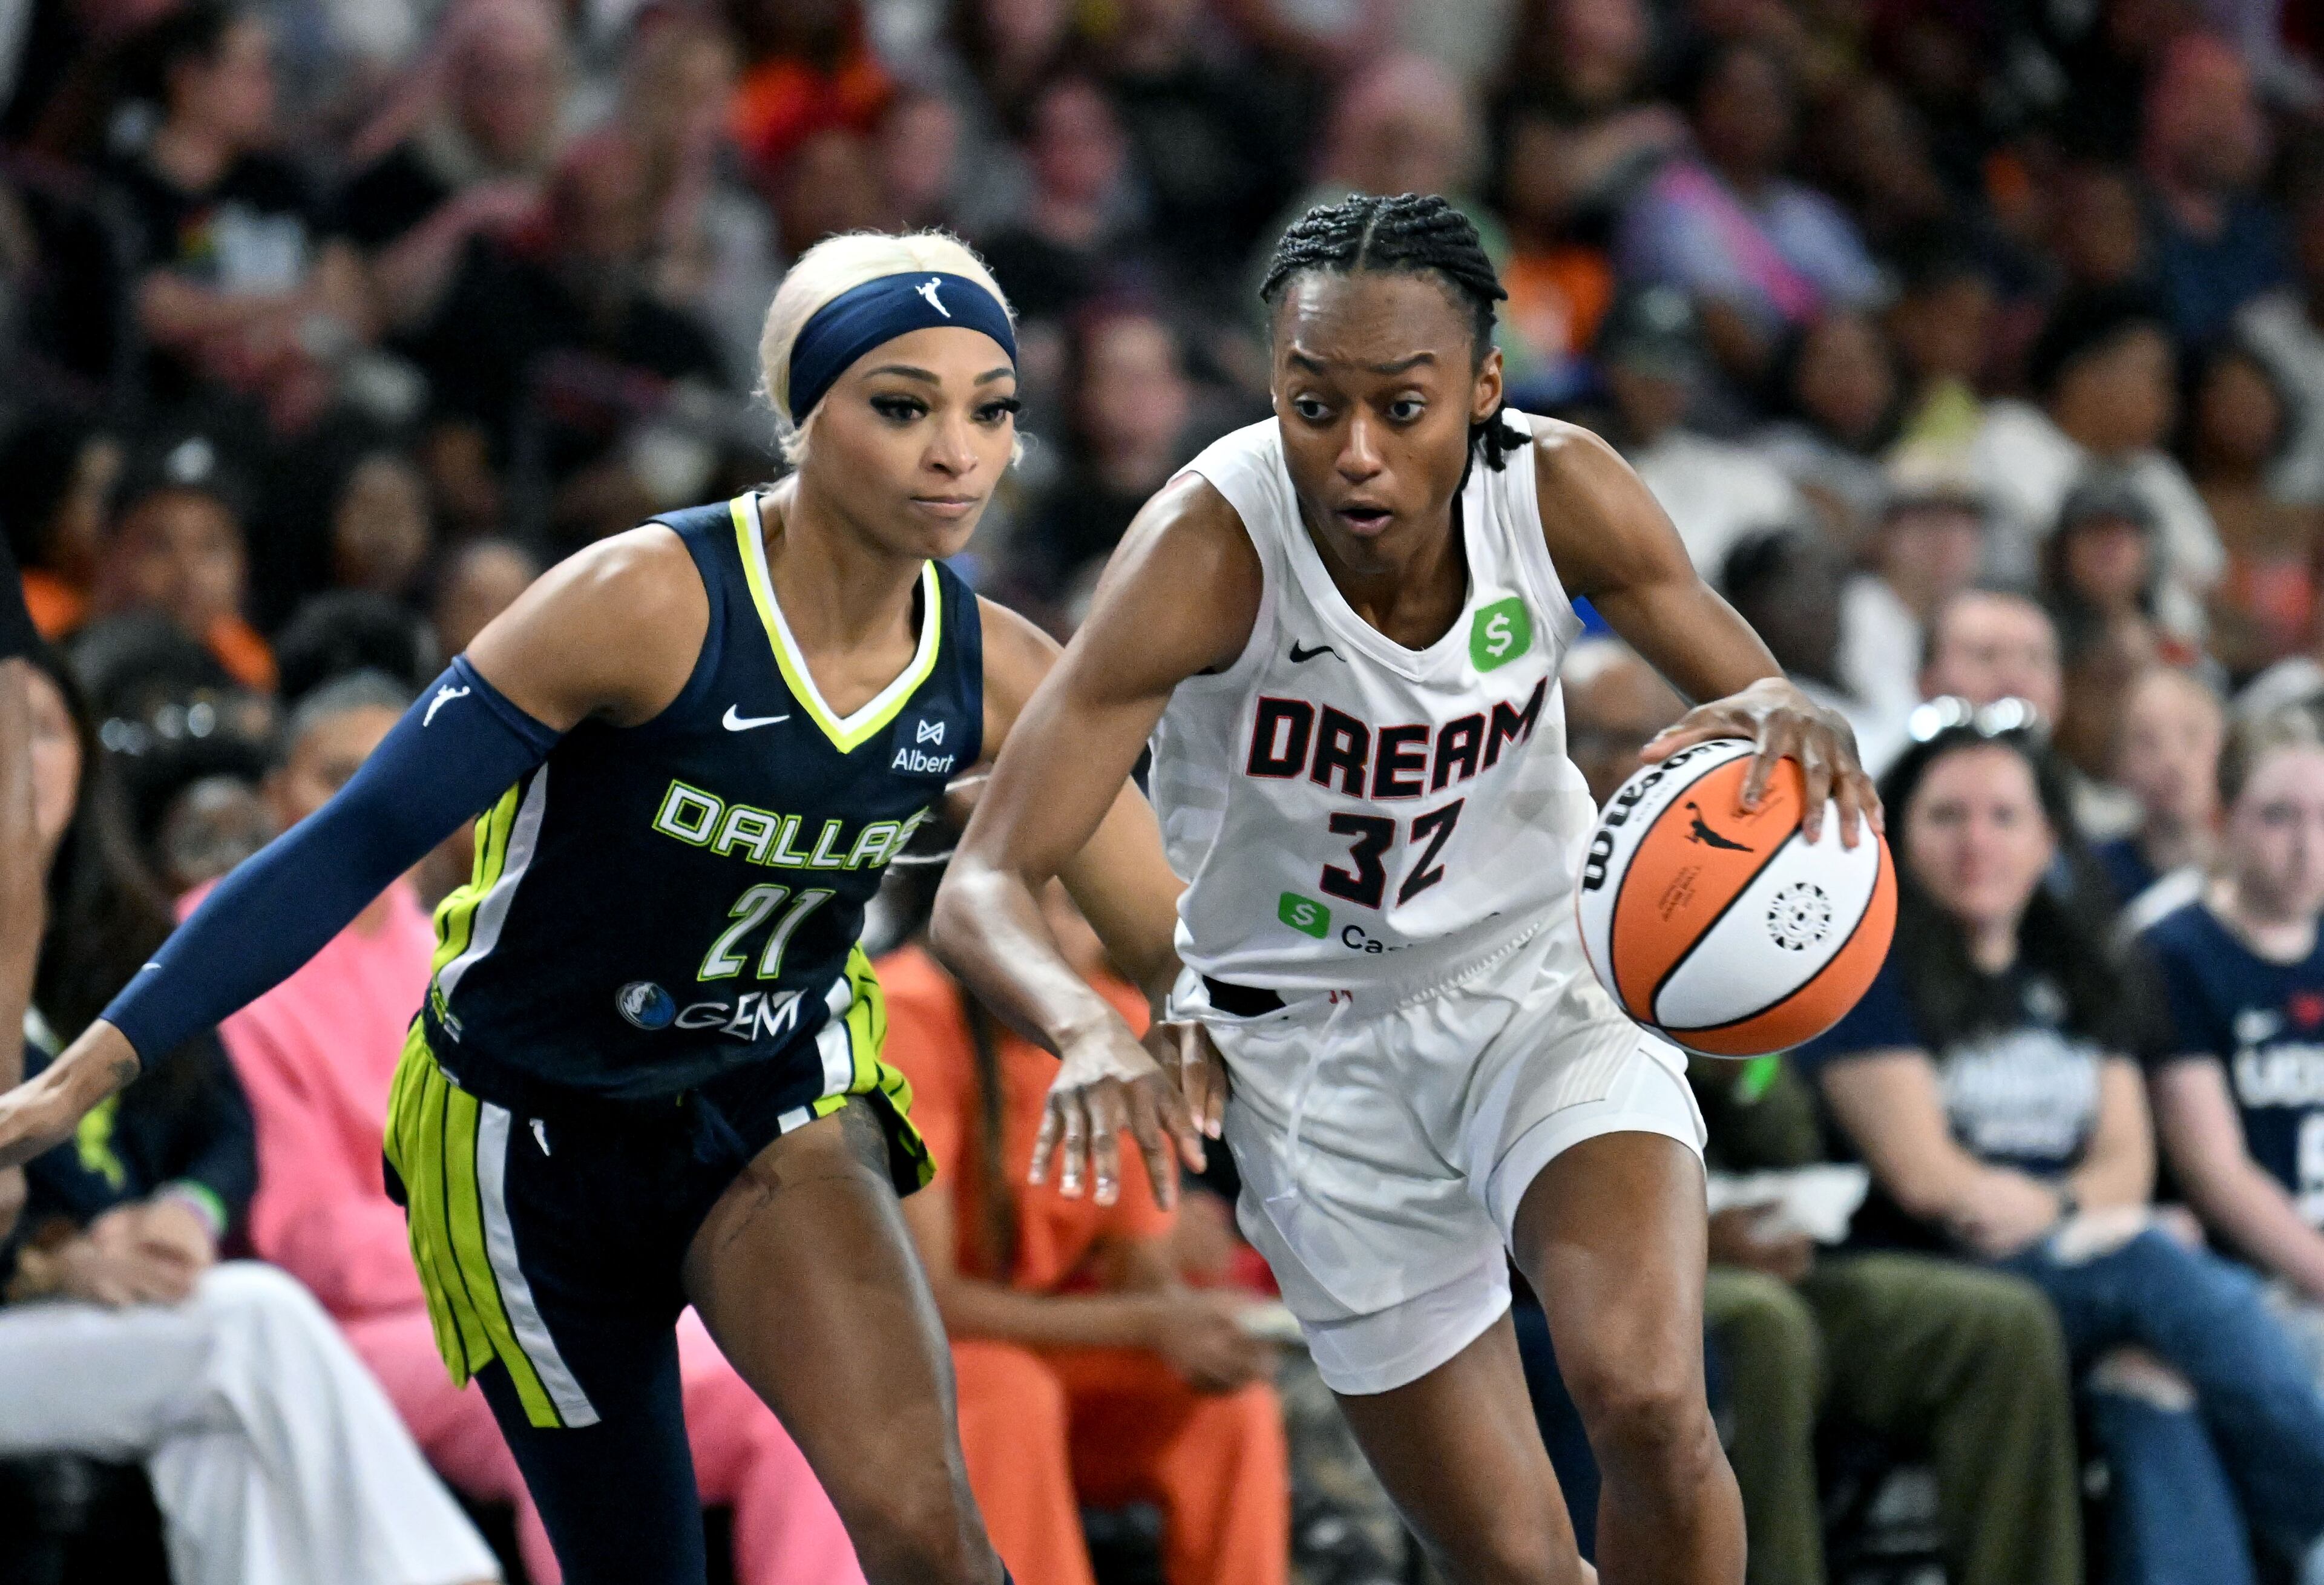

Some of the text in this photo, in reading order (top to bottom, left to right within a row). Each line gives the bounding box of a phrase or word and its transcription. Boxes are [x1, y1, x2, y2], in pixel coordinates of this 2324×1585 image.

[891, 747, 954, 773] Albert
[1246, 675, 1548, 800] DREAM
[1319, 797, 1465, 910] 32
[697, 883, 836, 982] 21
[674, 988, 809, 1041] GEM
